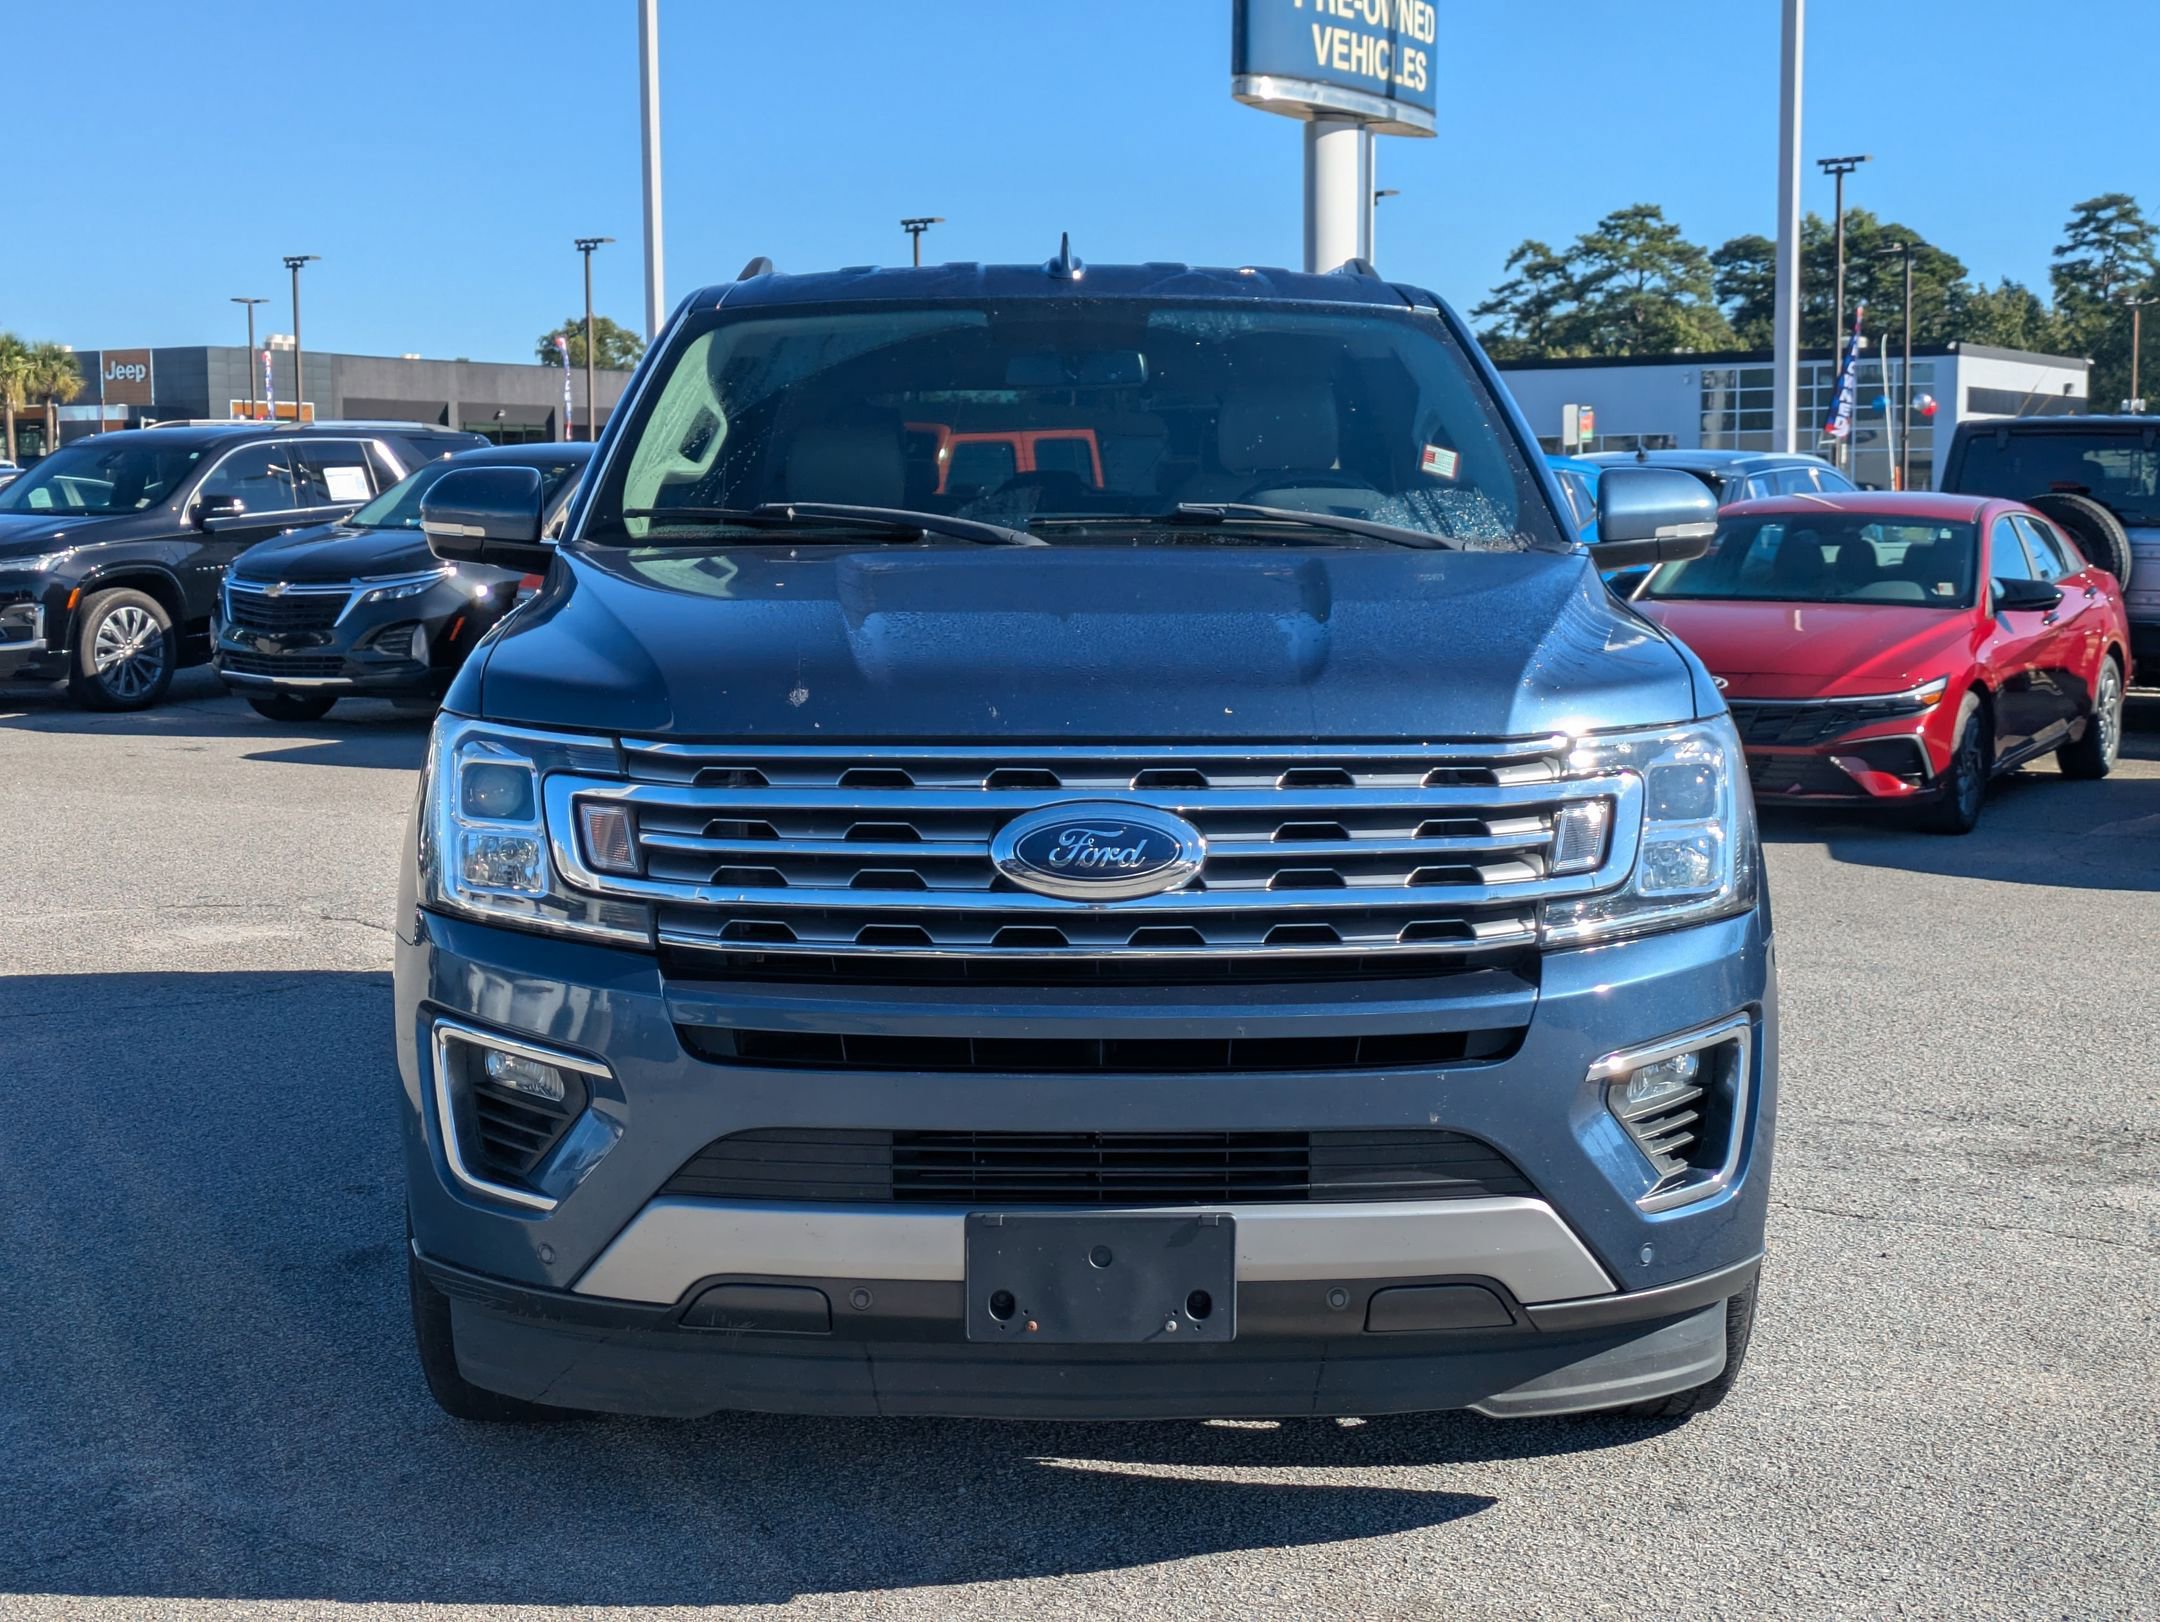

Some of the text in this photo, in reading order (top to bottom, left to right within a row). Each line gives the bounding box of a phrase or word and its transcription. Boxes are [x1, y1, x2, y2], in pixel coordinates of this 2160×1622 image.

[1294, 0, 1435, 44] -OWNED
[1312, 23, 1427, 92] VEHICLES
[105, 360, 146, 383] Jeep
[1048, 827, 1149, 868] Ford
